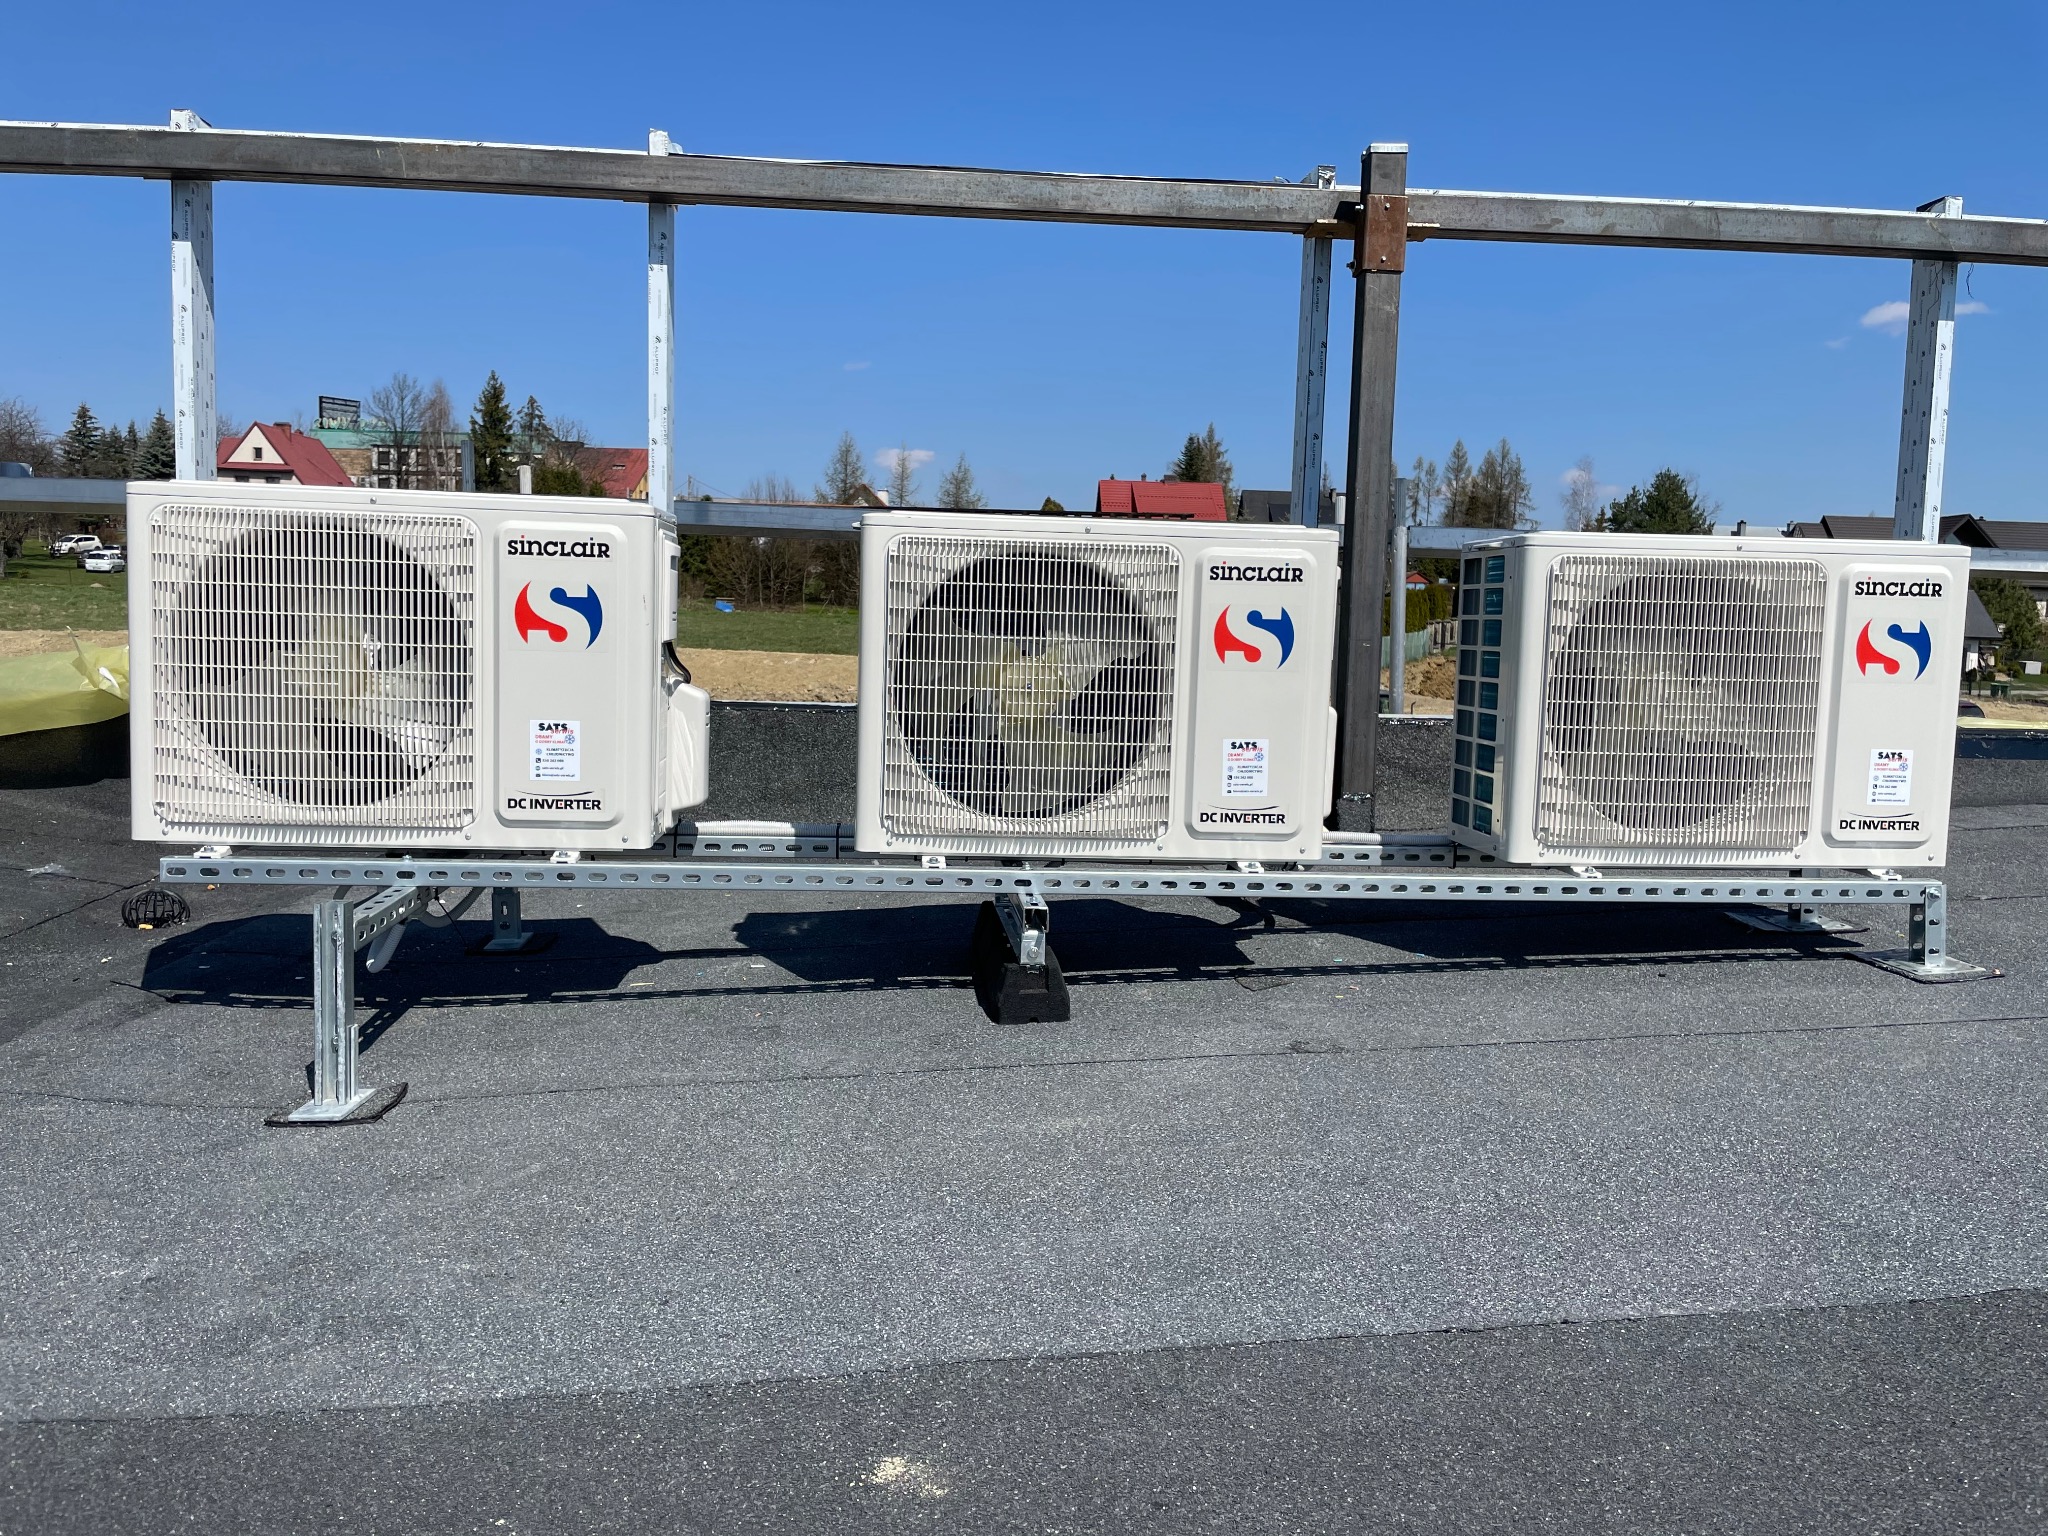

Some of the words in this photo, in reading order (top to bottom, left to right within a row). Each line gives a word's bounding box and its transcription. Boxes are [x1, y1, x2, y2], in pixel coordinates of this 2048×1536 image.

[538, 722, 568, 732] SATS
[1230, 741, 1257, 750] SATS
[1877, 751, 1903, 760] SATS
[507, 798, 526, 809] DC
[529, 798, 602, 810] INVERTER
[1200, 812, 1217, 823] DC
[1220, 812, 1286, 824] INVERTER
[1839, 819, 1856, 830] DC
[1858, 819, 1920, 831] INVERTER
